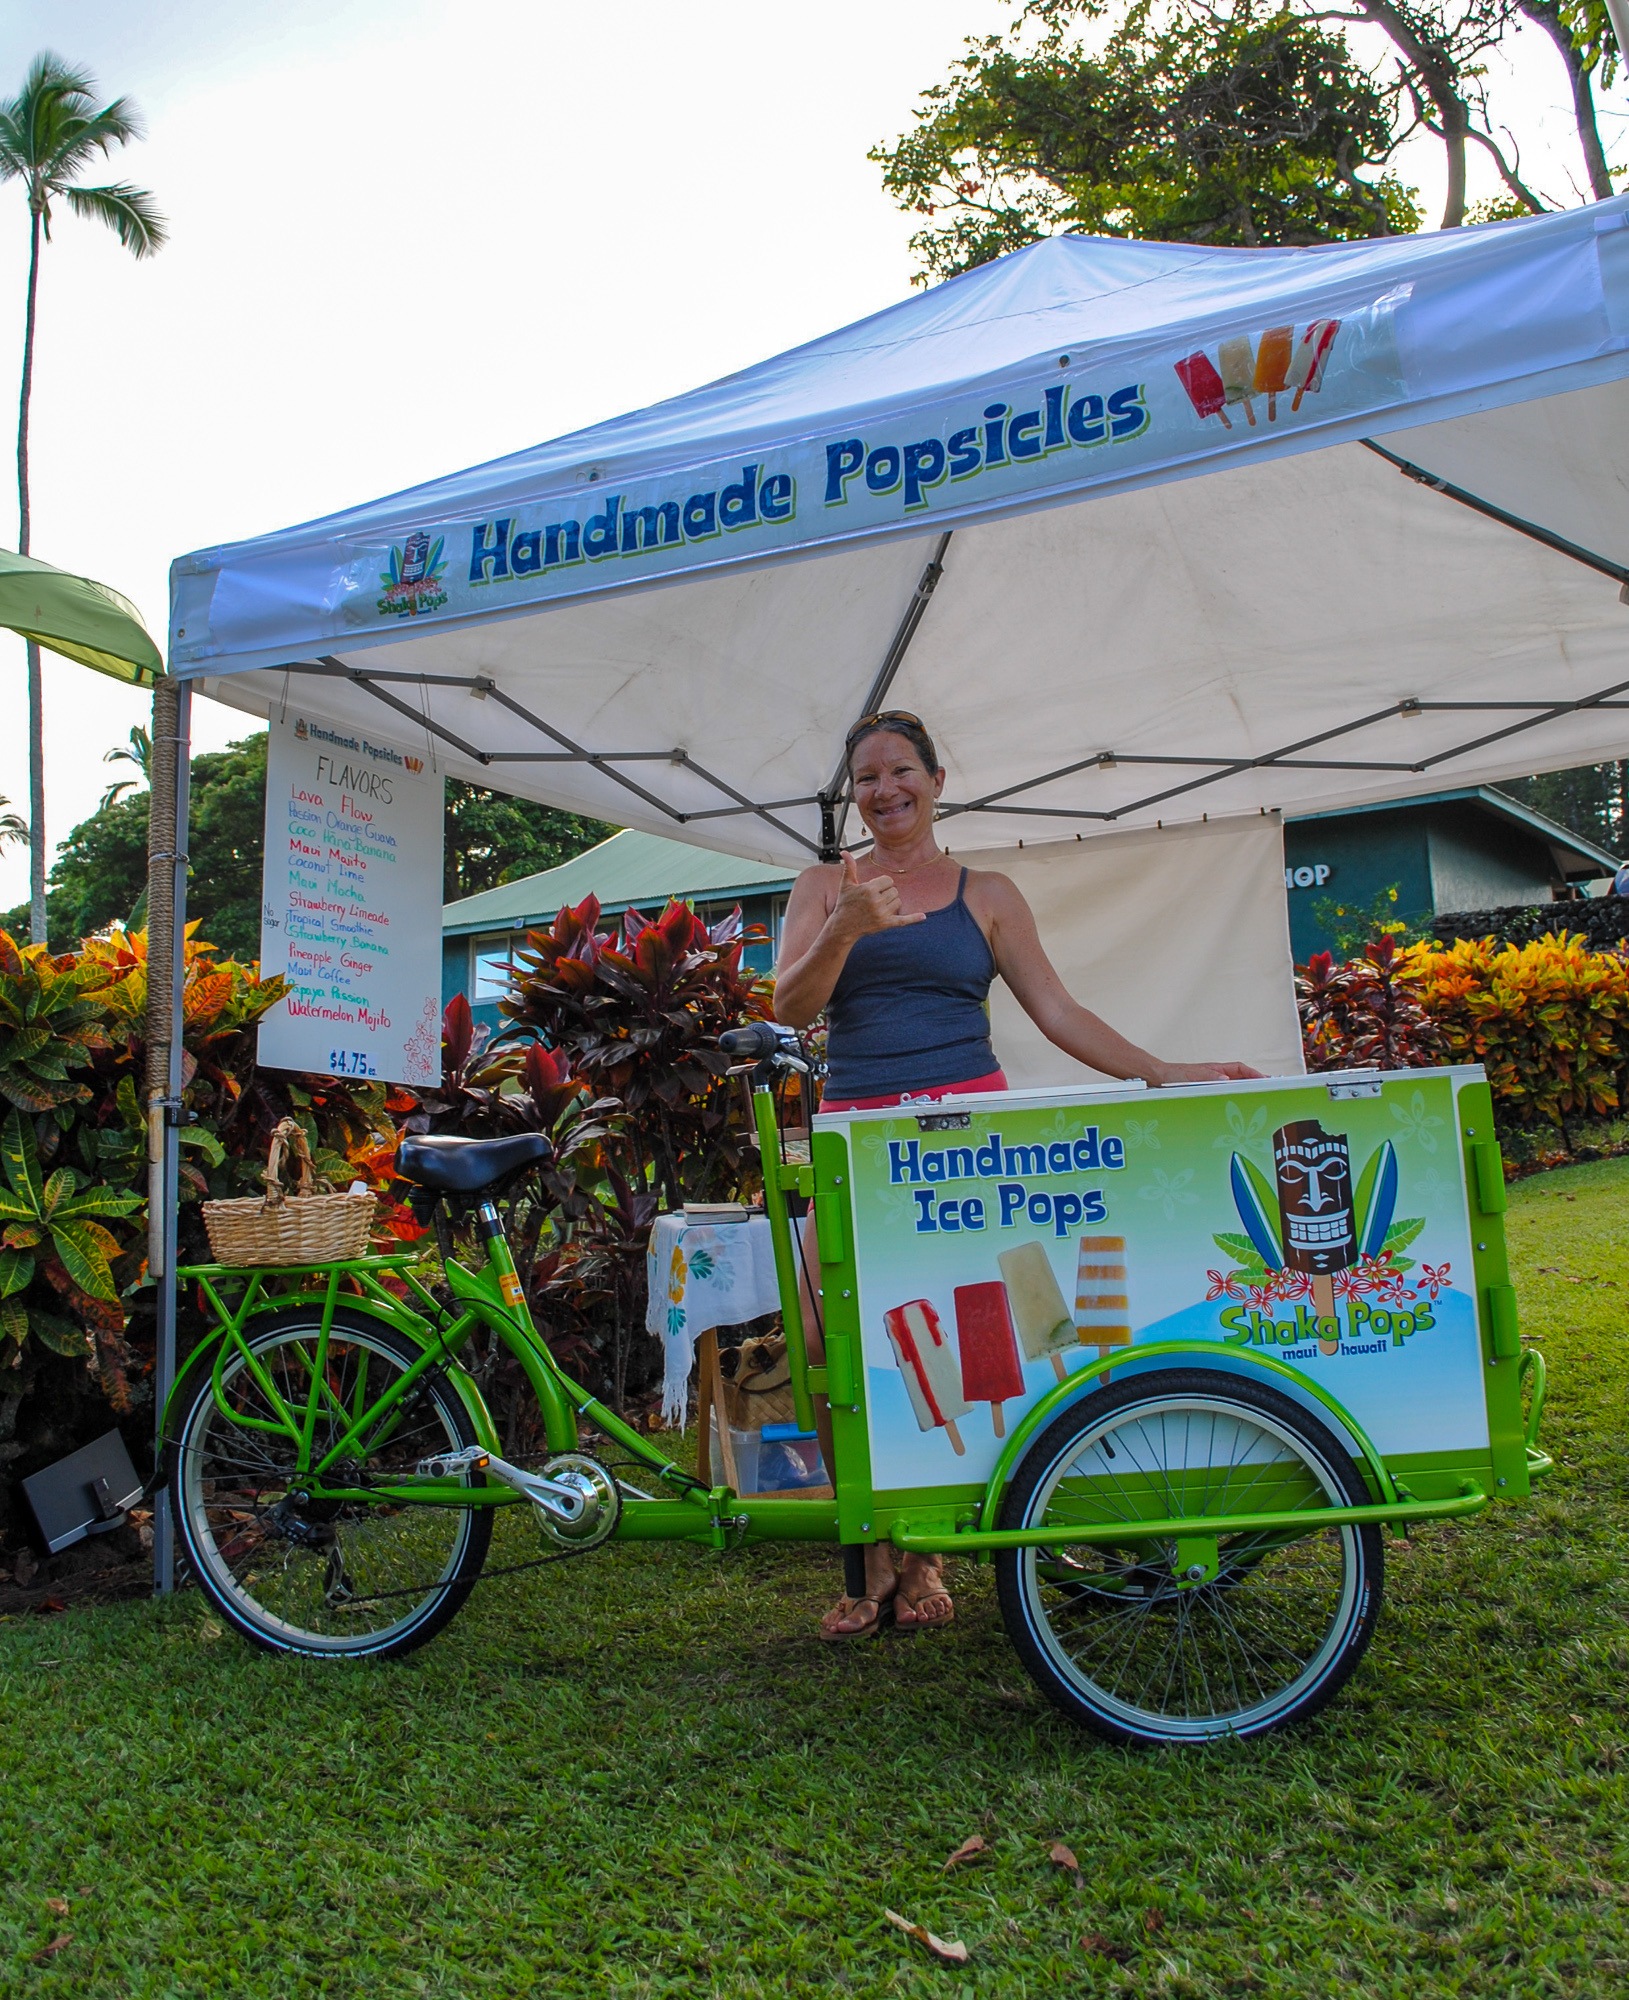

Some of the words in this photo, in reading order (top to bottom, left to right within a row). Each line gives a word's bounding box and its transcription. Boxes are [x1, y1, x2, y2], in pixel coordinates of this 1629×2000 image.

[468, 464, 797, 588] Handmade
[824, 384, 1151, 513] Popsicles
[418, 592, 448, 610] Pops
[310, 723, 360, 752] Handmade
[363, 740, 403, 766] Popsicles
[317, 755, 394, 805] FLAVORS
[291, 783, 324, 807] Lava
[341, 794, 373, 823] Flow
[288, 801, 322, 824] Passion
[326, 811, 363, 841] Orange
[364, 823, 398, 847] Guava
[288, 821, 316, 838] Coco
[354, 837, 397, 863] Banana
[289, 838, 321, 857] Maui
[287, 854, 333, 874] Coconut
[339, 864, 365, 884] Lime
[288, 870, 318, 890] Maui
[327, 878, 367, 903] Mocha
[263, 902, 275, 917] No
[286, 909, 325, 929] Tropical
[330, 918, 374, 937] Smoothie
[289, 890, 346, 923] Strawberry
[349, 904, 390, 926] Limeade
[288, 924, 347, 949] Strawberry
[350, 936, 390, 956] Banana
[287, 961, 313, 977] Maui
[317, 966, 351, 985] Coffee
[288, 942, 332, 969] Pineapple
[340, 952, 374, 977] Ginger
[331, 985, 371, 1008] Passion
[287, 998, 355, 1024] Watermelon
[357, 1007, 392, 1032] Mojito
[330, 1050, 367, 1075] $4.75
[887, 1126, 1126, 1185] Handmade
[912, 1187, 987, 1234] Ice
[996, 1182, 1108, 1239] Pops
[1219, 1305, 1342, 1346] Shaka
[1345, 1301, 1436, 1347] Pops
[1282, 1345, 1318, 1360] maui
[1340, 1340, 1387, 1356] hawaii
